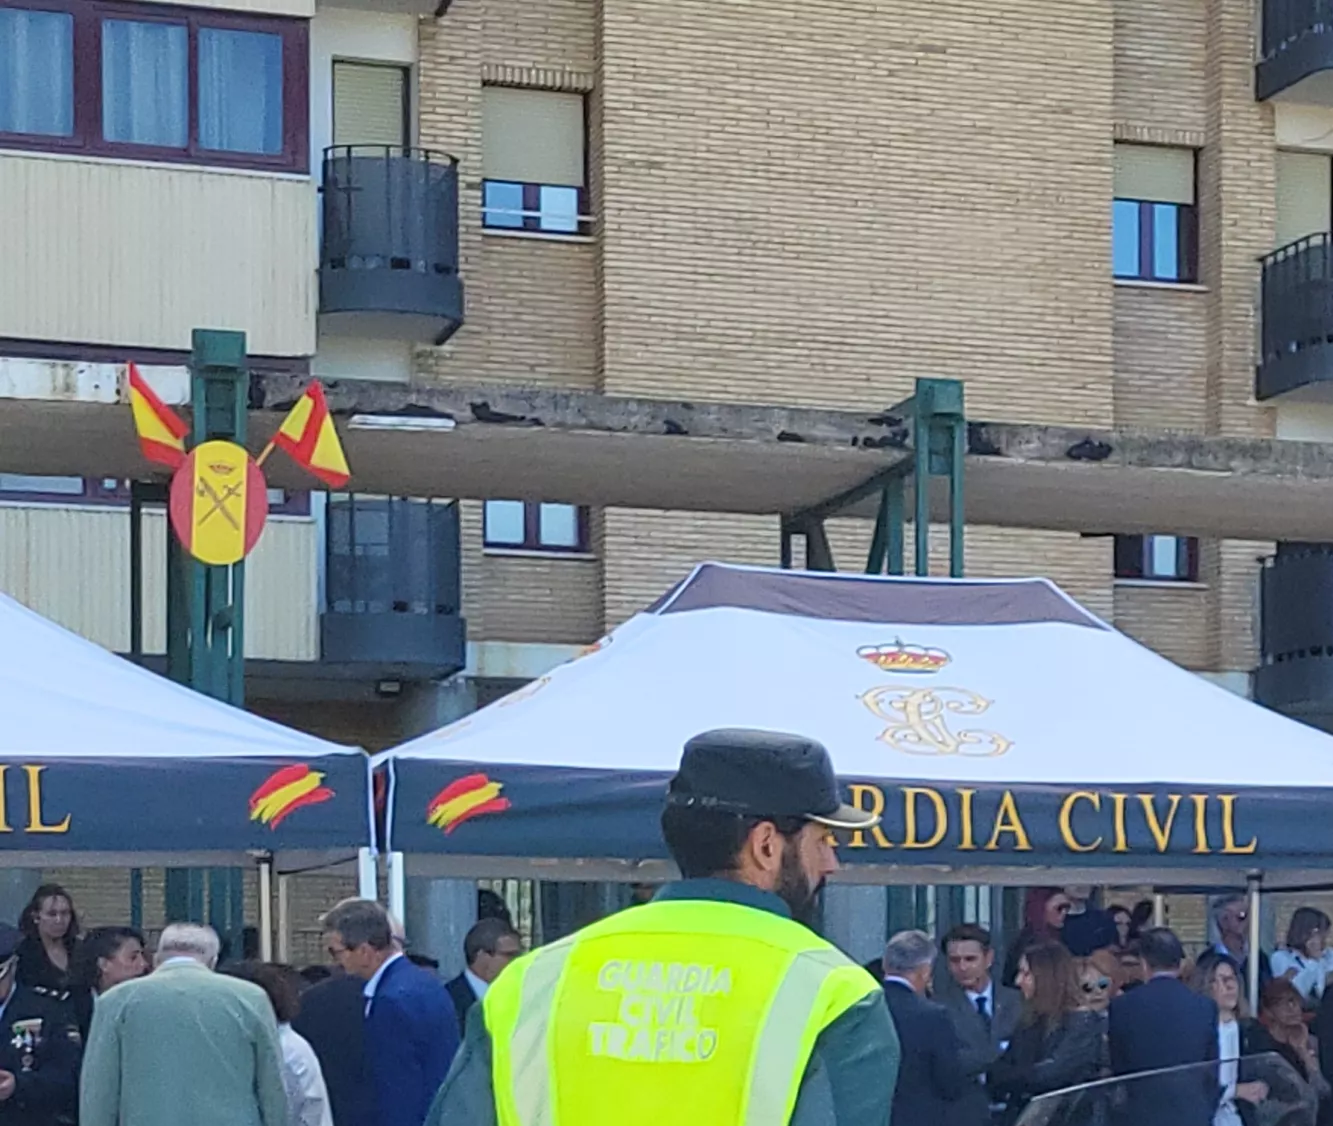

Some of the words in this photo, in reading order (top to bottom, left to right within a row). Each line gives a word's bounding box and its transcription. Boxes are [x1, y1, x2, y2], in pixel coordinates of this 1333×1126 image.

[826, 784, 1032, 851] RDIA
[1058, 791, 1258, 854] CIVIL
[598, 959, 732, 996] GUARDIA
[620, 993, 698, 1027] CIVIL
